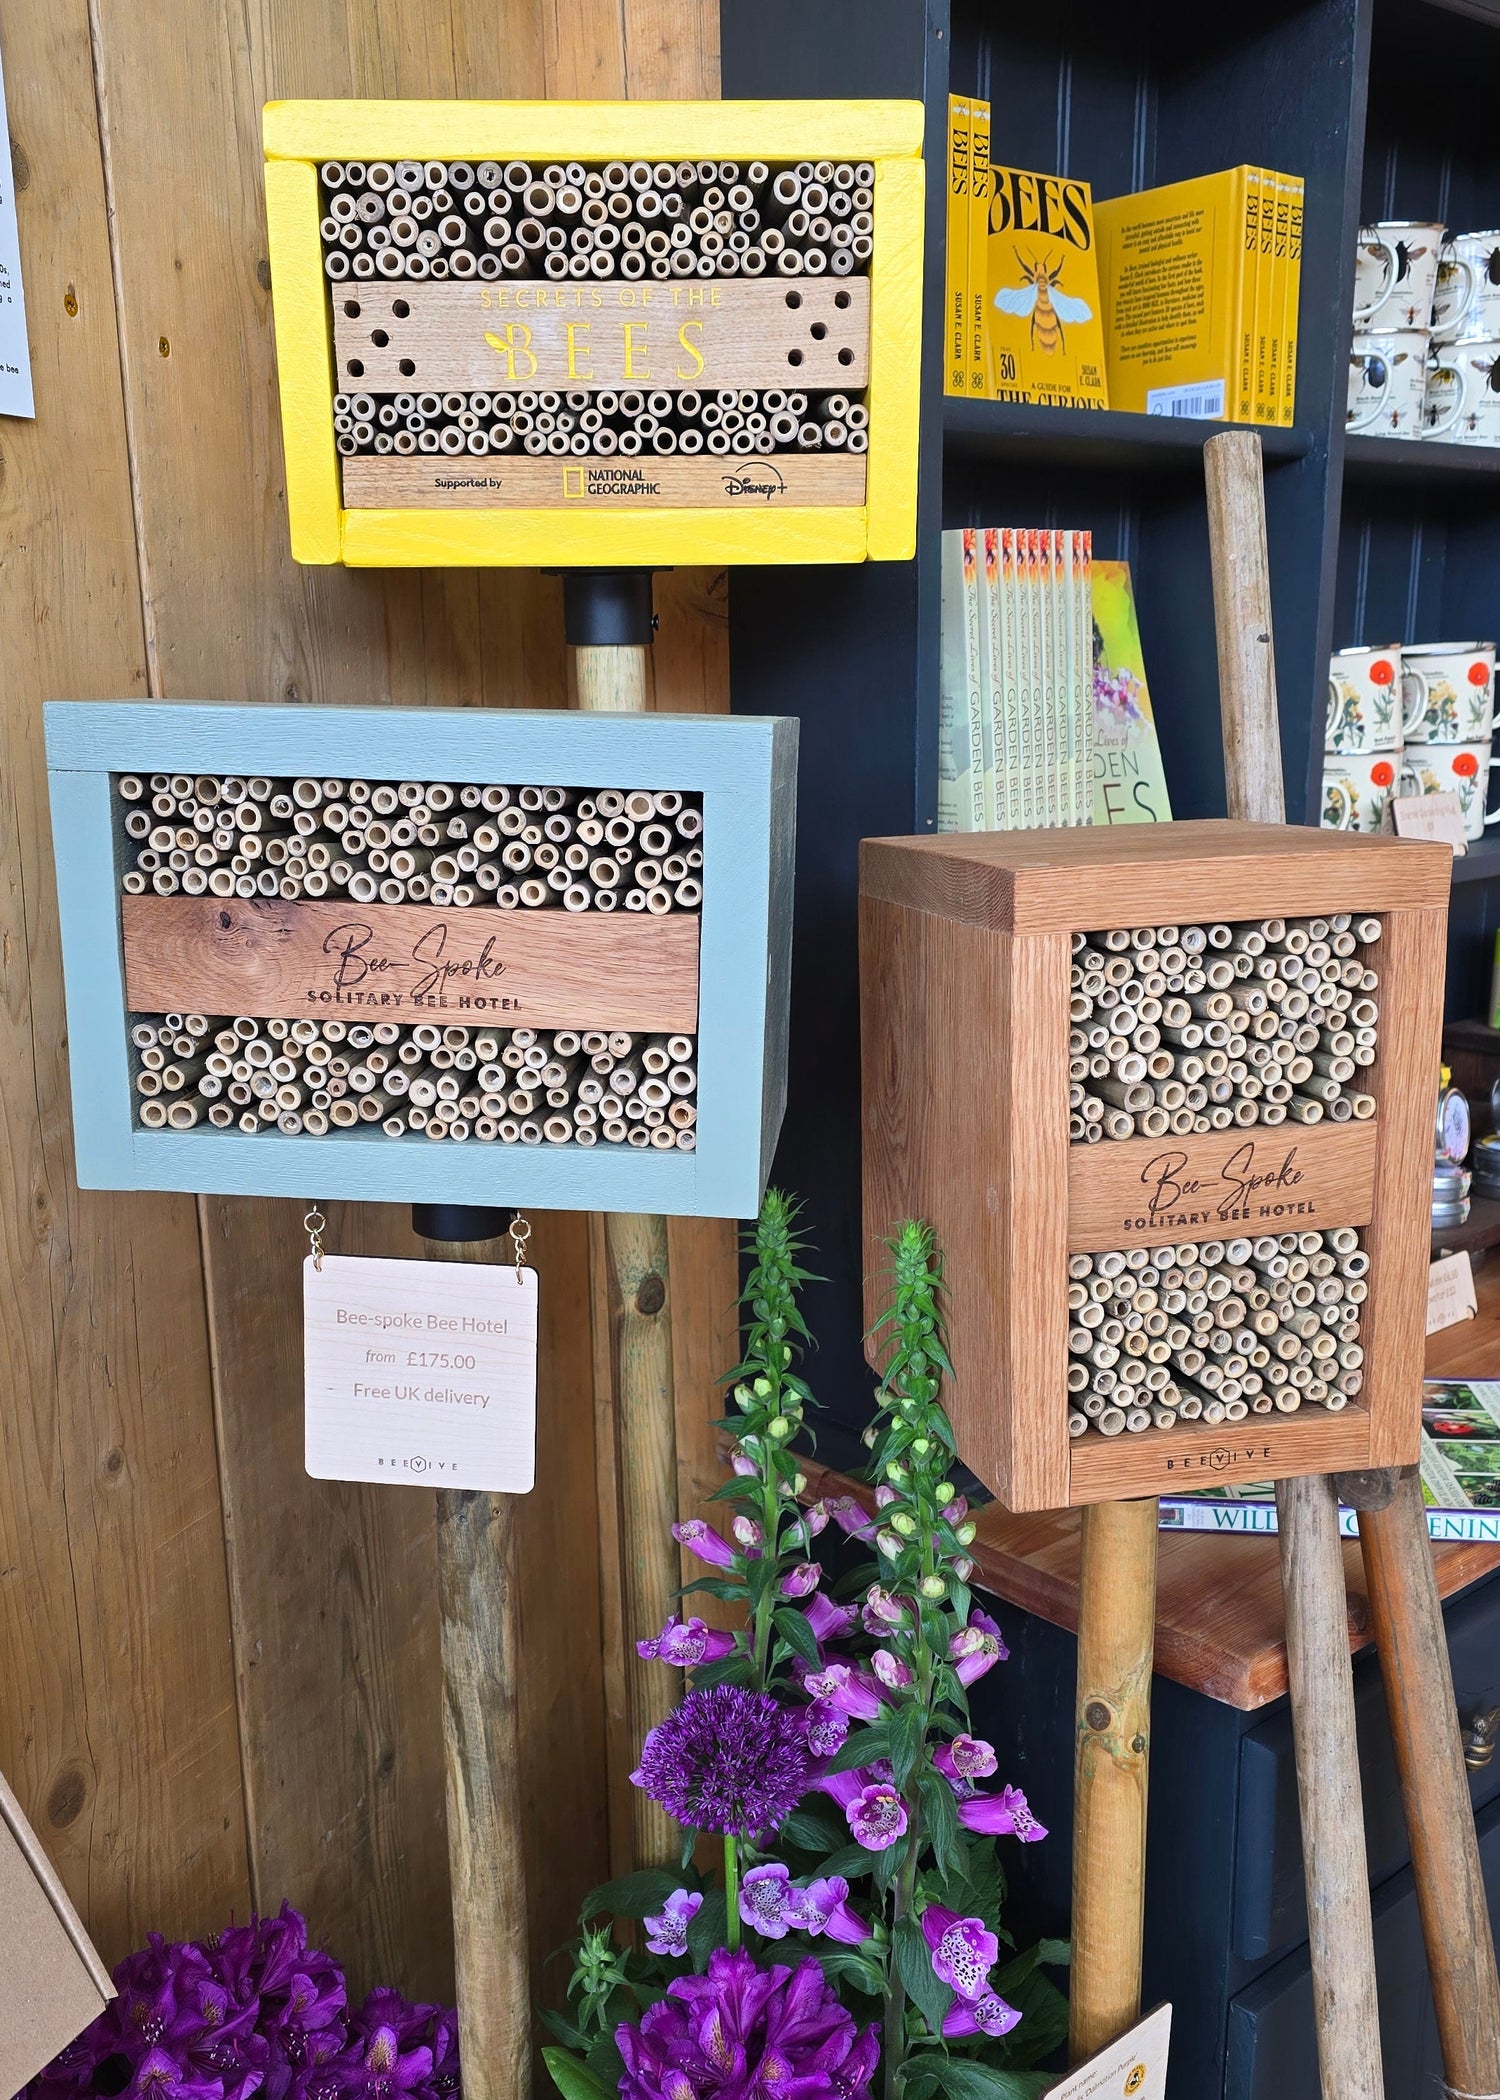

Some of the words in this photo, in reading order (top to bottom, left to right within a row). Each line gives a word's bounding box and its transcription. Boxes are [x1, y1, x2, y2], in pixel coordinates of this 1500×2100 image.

[953, 128, 968, 195] BEES
[973, 132, 988, 198] BEES
[988, 168, 1090, 251] BEES
[1245, 194, 1258, 250] BEES
[1262, 198, 1274, 254] BEES
[1275, 202, 1289, 257] BEES
[1289, 205, 1302, 259] BEES
[480, 288, 602, 308] SECRETS
[619, 288, 653, 307] OF
[670, 287, 722, 307] THE
[955, 291, 963, 320] SUSAN
[974, 294, 982, 322] SUSAN
[486, 321, 705, 381] BEES
[954, 332, 963, 360] CLARK
[973, 334, 982, 361] CLARK
[6, 363, 19, 374] bee
[1000, 353, 1016, 381] 30
[1081, 364, 1098, 376] SUSAN
[1036, 382, 1057, 392] GUIDE
[1058, 384, 1072, 393] FOR
[435, 477, 488, 490] Supported
[489, 477, 502, 490] by
[588, 469, 645, 482] NATIONAL
[588, 482, 661, 496] GEOGRAPHIC
[968, 584, 978, 607] The
[990, 585, 1000, 607] The
[1005, 583, 1014, 605] The
[968, 609, 978, 640] Secret
[991, 609, 1001, 640] Secret
[1006, 608, 1014, 638] Secret
[969, 643, 979, 673] Lives
[992, 643, 1001, 672] Lives
[1007, 640, 1015, 670] Lives
[970, 691, 982, 774] GARDEN
[992, 691, 1004, 773] GARDEN
[1007, 688, 1018, 770] GARDEN
[1021, 688, 1031, 770] GARDEN
[1033, 687, 1043, 768] GARDEN
[1045, 687, 1055, 767] GARDEN
[1058, 685, 1067, 765] GARDEN
[1094, 728, 1120, 747] Lives
[1121, 725, 1132, 752] of
[973, 781, 984, 822] BEES
[995, 780, 1005, 822] BEES
[1009, 777, 1019, 818] BEES
[1023, 777, 1032, 818] BEES
[1035, 775, 1044, 815] BEES
[1047, 774, 1056, 814] BEES
[1060, 772, 1069, 812] BEES
[323, 923, 507, 998] Bee-Spoke
[307, 990, 403, 1007] SOLITARY
[414, 994, 448, 1008] BEE
[459, 996, 522, 1011] HOTEL
[1141, 1142, 1304, 1216] Bee-Spoke
[1124, 1211, 1210, 1231] SOLITARY
[1219, 1207, 1250, 1221] BEE
[1259, 1202, 1315, 1217] HOTEL
[336, 1309, 423, 1330] Bee-spoke
[427, 1314, 458, 1331] Bee
[462, 1317, 508, 1335] Hotel
[365, 1349, 396, 1364] from
[407, 1352, 476, 1370] £175.00
[354, 1383, 391, 1400] Free
[395, 1385, 421, 1401] UK
[424, 1387, 490, 1409] delivery
